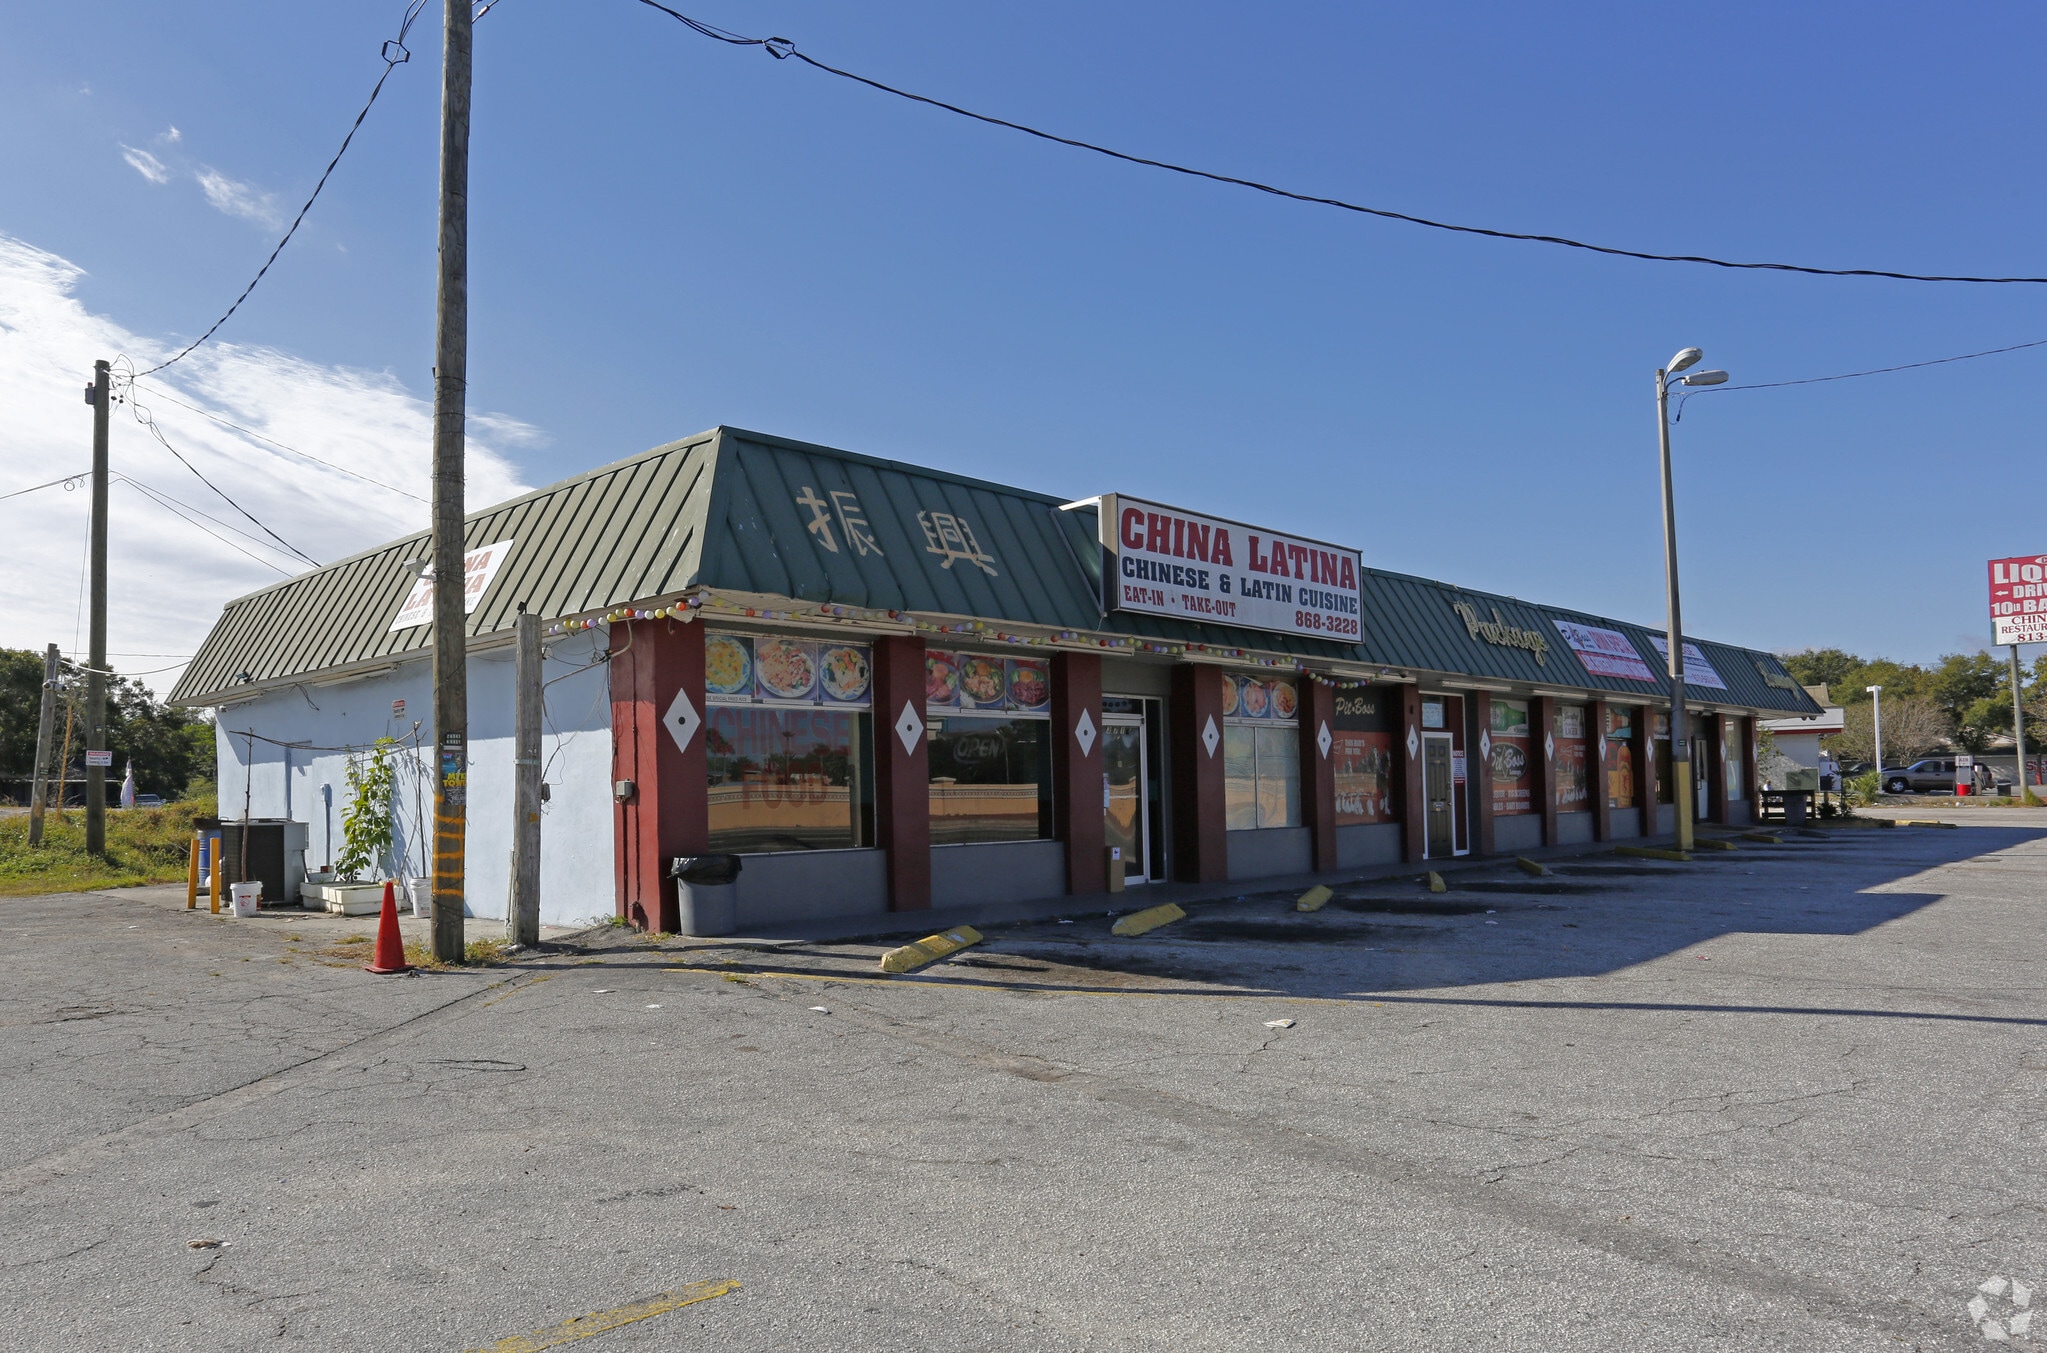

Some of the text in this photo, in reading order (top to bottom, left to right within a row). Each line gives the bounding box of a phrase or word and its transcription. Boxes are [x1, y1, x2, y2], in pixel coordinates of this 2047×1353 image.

[1121, 508, 1357, 590] CHINA LATINA
[1122, 556, 1358, 615] CHINESE & LATIN CUISINE
[1124, 585, 1236, 618] EAT-IN TAKE-OUT
[1295, 610, 1358, 635] 868-3228
[1335, 697, 1376, 716] Pit Boss
[711, 707, 852, 757] CHINESE
[957, 738, 999, 758] OPEN
[1503, 748, 1525, 768] Boss
[741, 761, 828, 810] FOOD
